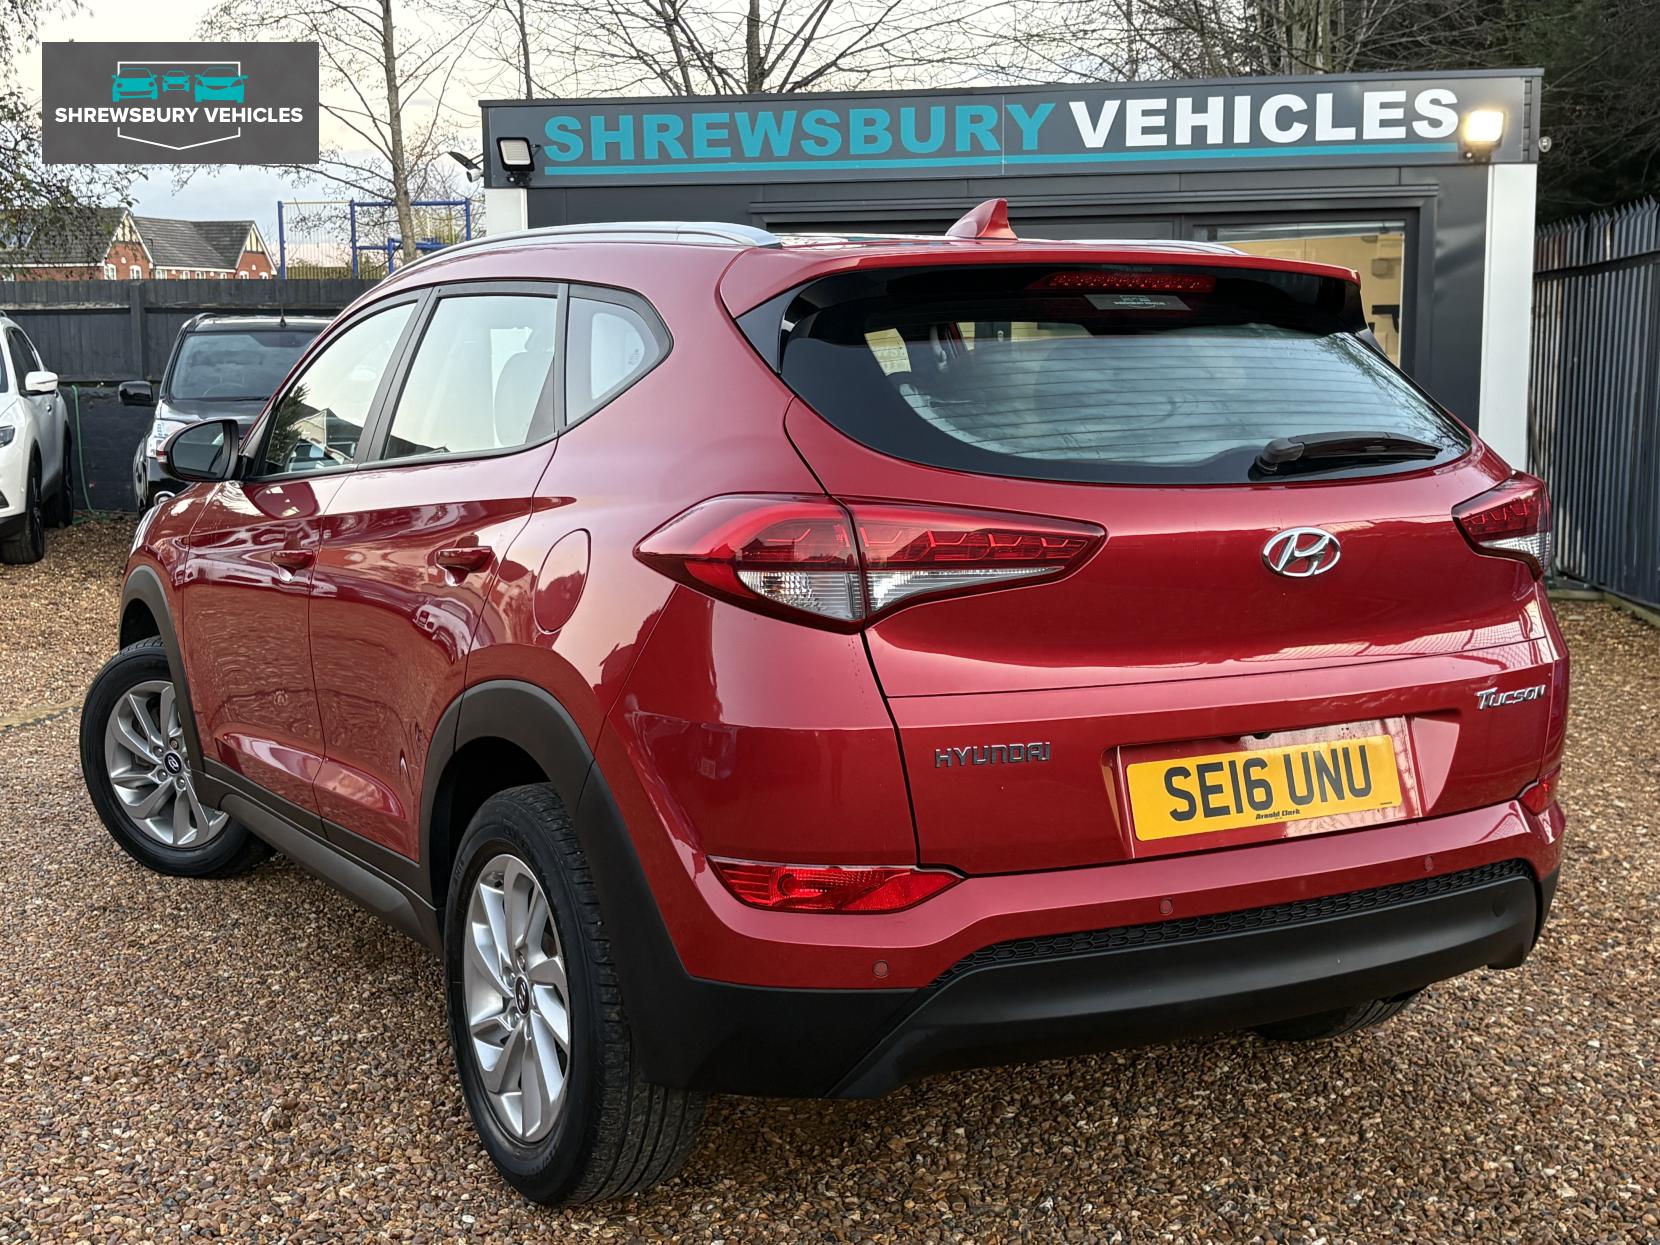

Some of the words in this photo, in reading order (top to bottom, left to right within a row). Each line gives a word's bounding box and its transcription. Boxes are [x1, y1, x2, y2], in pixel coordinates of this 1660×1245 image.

[544, 103, 1056, 161] SHREWSBURY
[1068, 88, 1459, 148] VEHICLES
[934, 741, 1051, 768] HYUNDAI
[1163, 757, 1274, 822] SE16
[1283, 744, 1372, 806] UNU
